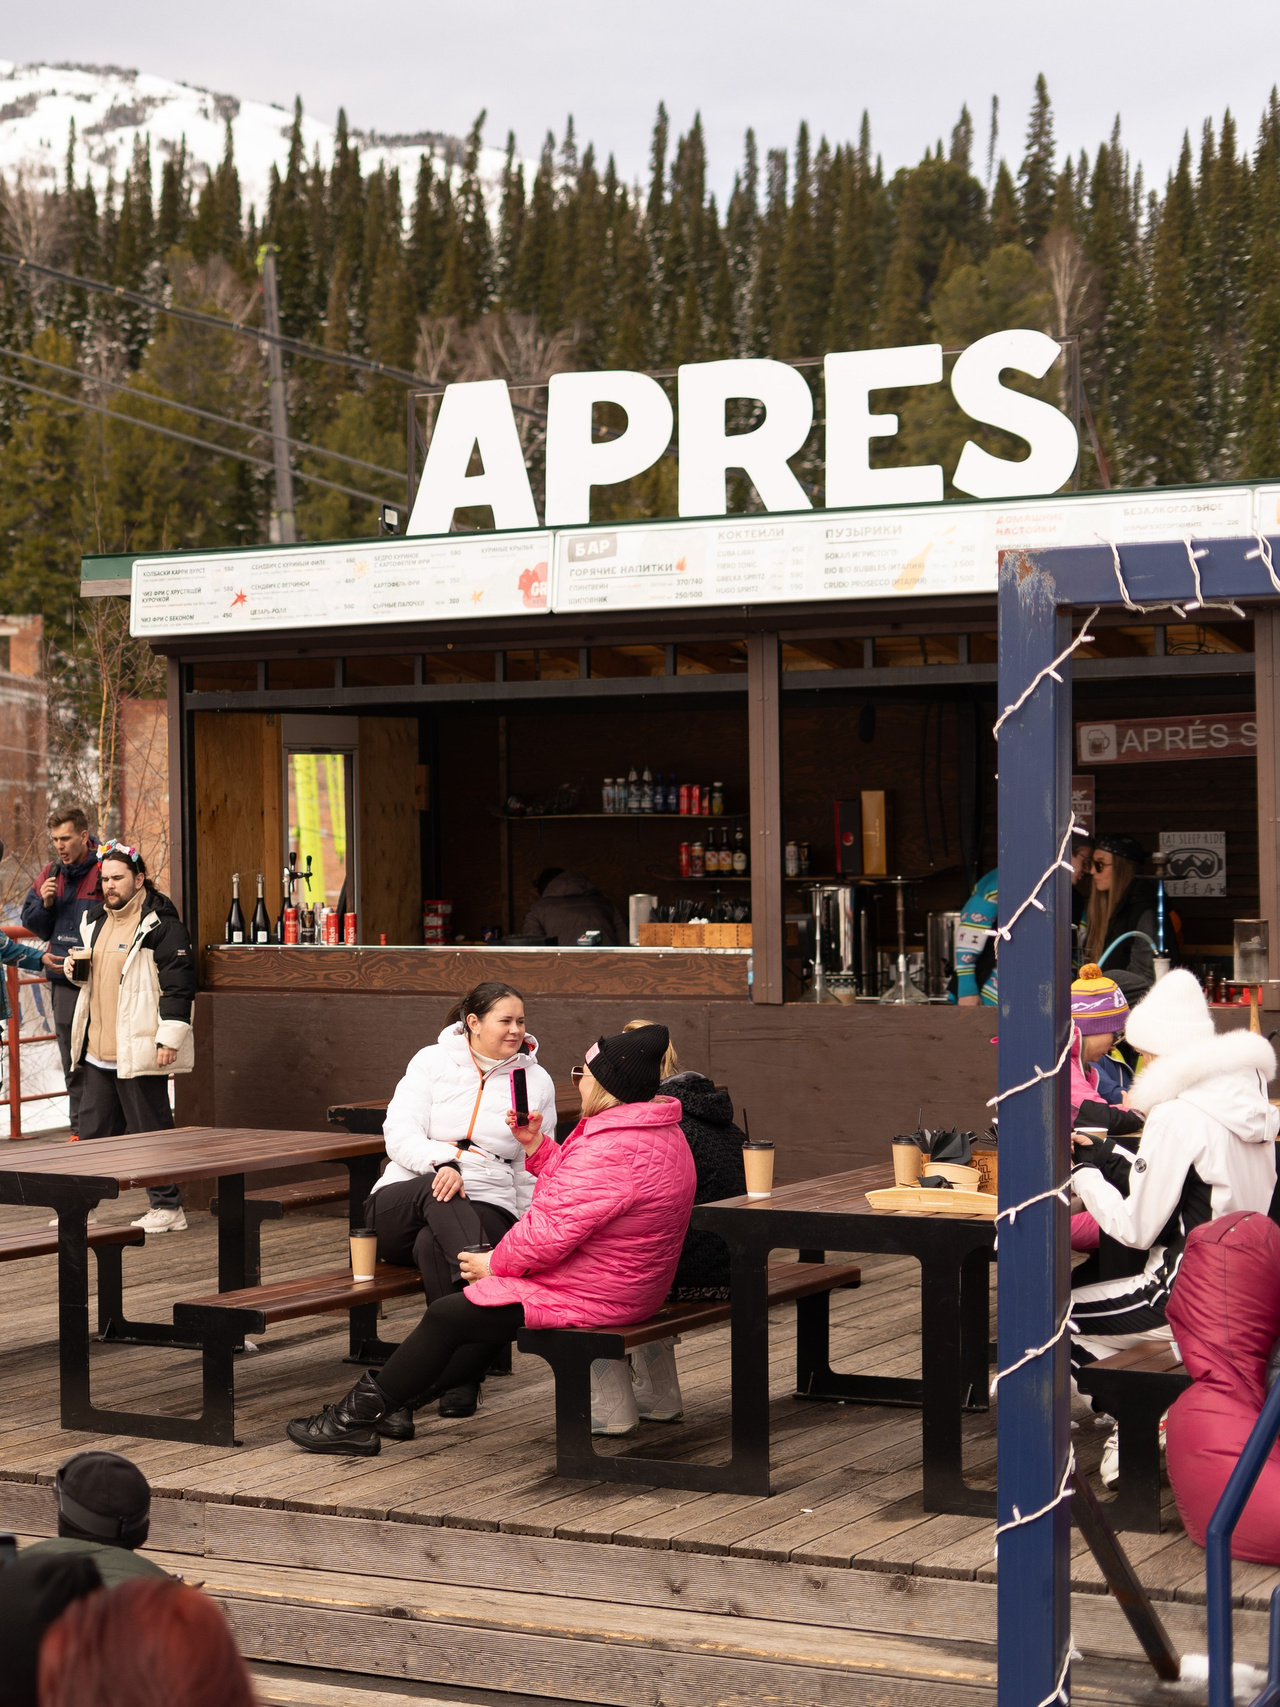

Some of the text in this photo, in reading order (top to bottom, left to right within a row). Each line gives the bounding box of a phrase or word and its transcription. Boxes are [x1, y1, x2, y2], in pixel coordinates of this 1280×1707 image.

[406, 329, 1078, 536] APRES
[1123, 503, 1224, 516] БЕЗАЛКОГОЛЬНОЕ
[996, 512, 1065, 525] ДОМАШНИЕ
[825, 525, 903, 539] ПУЗЫРИКИ
[575, 540, 610, 557] БАР
[825, 552, 848, 560] БОКАЛ
[143, 570, 171, 578] КОЛБАСКИ
[570, 563, 673, 577] ГОРЯЧИЕ НАПИТКИ
[824, 566, 837, 574] BIO
[676, 578, 703, 586] 370/740
[824, 581, 849, 589] CRUDO
[851, 579, 890, 588] PROSECCO
[142, 596, 170, 604] КУРОЧКОЙ
[568, 595, 608, 604] ШИПОВНИК
[675, 591, 703, 599] 250/500
[1121, 720, 1230, 754] APRÉS
[1162, 832, 1225, 844] EAT SLEEP RIDE
